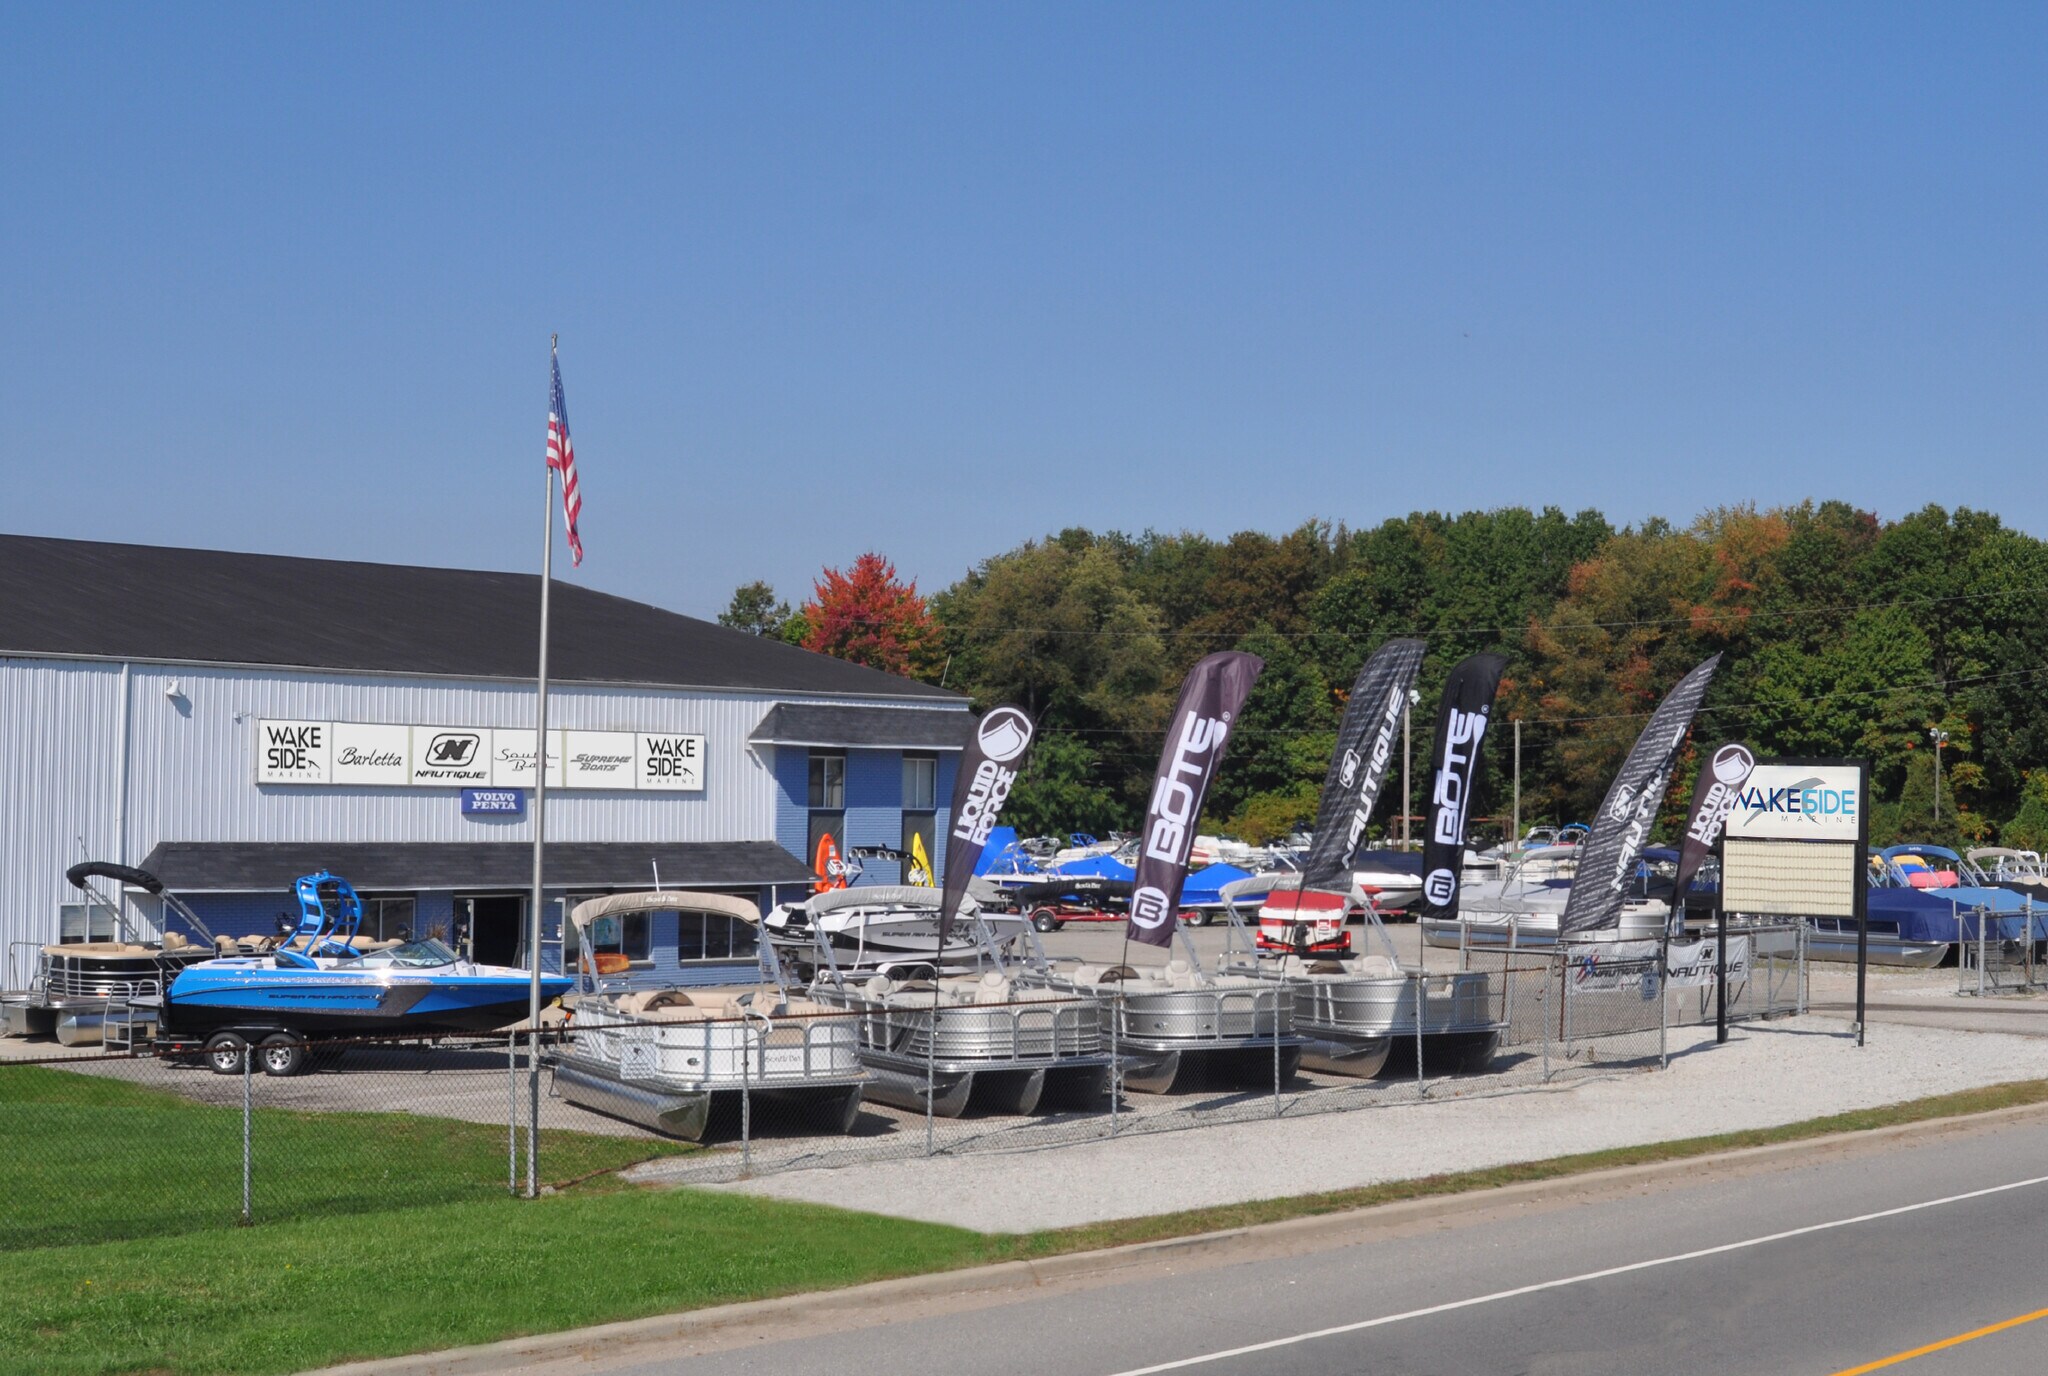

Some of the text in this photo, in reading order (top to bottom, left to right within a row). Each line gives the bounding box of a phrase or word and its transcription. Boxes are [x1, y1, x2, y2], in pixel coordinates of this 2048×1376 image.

[267, 726, 321, 748] WAKE
[338, 747, 402, 767] Barletta
[646, 738, 695, 757] WAKE
[267, 748, 306, 769] SIDE
[508, 759, 555, 772] Ba
[646, 757, 683, 776] SIDE
[267, 771, 321, 779] MARINE
[415, 770, 488, 780] NAUTIQUE
[471, 801, 517, 810] PENTA
[472, 792, 516, 801] VOLVO
[953, 760, 999, 841] LIQUID
[970, 766, 1018, 847] FORCE
[1687, 782, 1728, 843] LIQUID
[1701, 787, 1739, 848] FORCE
[1780, 815, 1856, 825] MARINE
